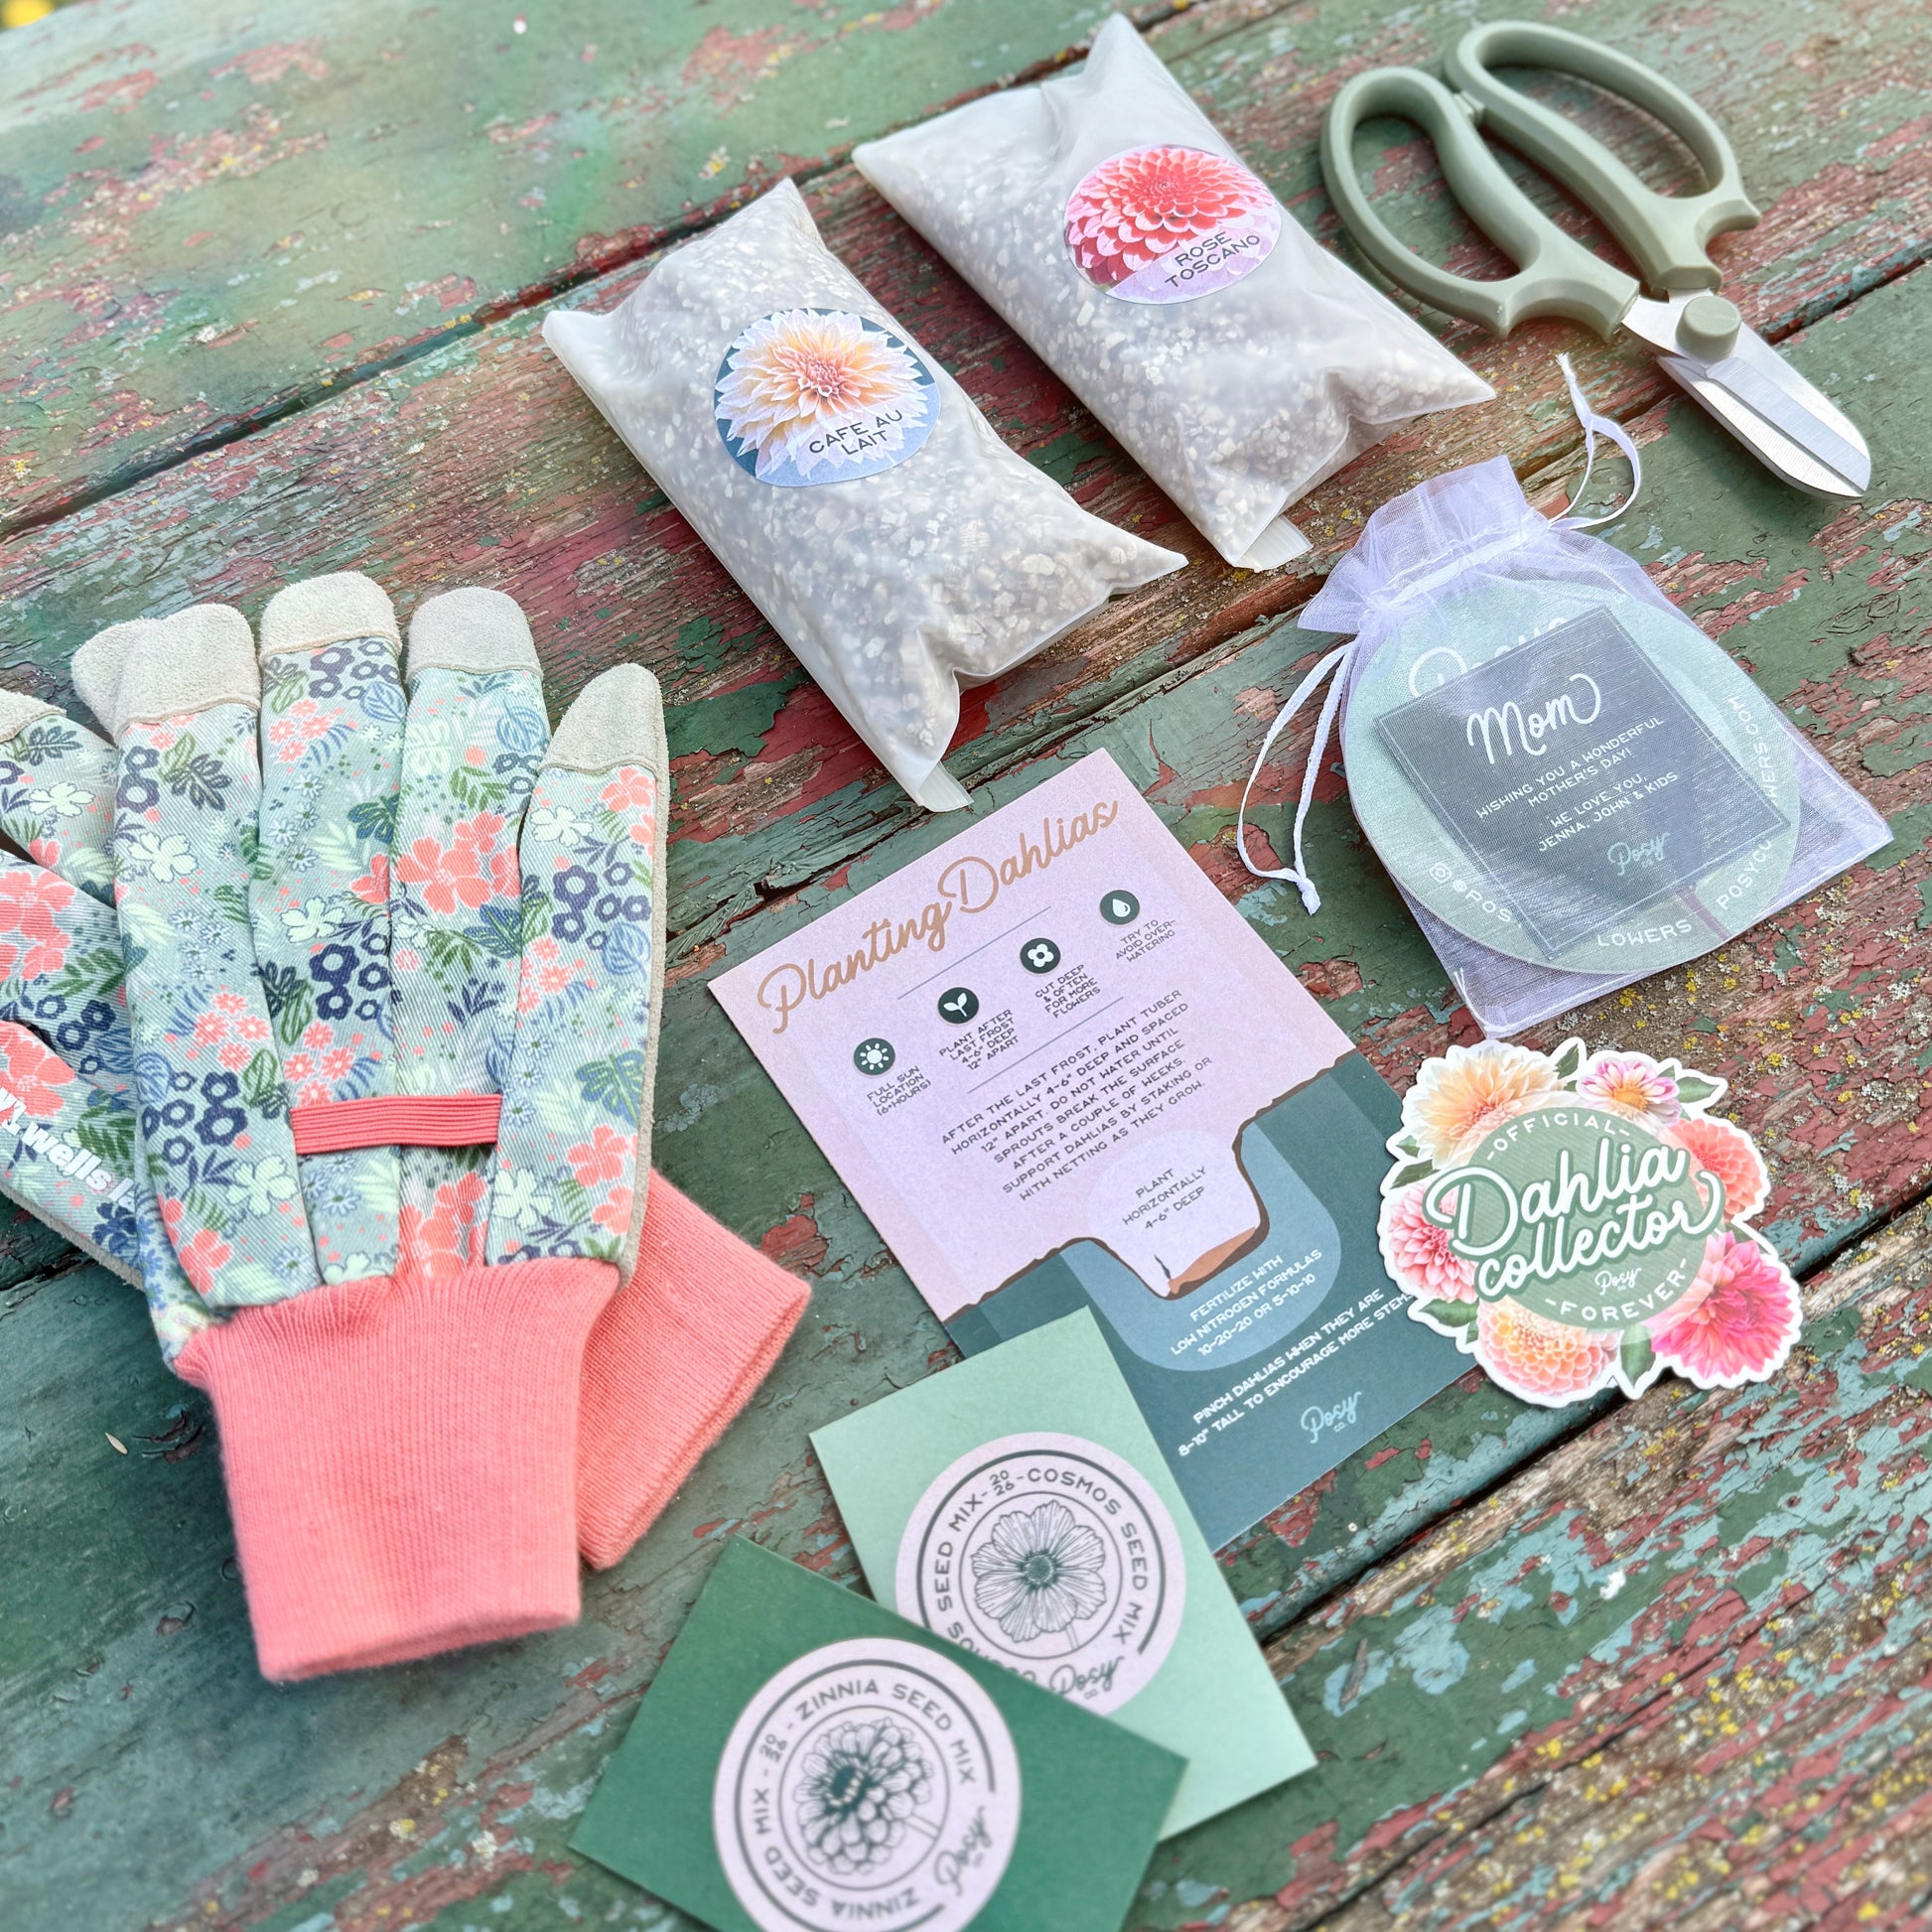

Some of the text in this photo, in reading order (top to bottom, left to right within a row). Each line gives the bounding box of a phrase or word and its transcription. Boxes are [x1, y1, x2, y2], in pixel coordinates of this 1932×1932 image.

[1165, 234, 1260, 287] TOSCANO
[1174, 231, 1232, 266] ROSE
[809, 409, 903, 454] CAFE AU
[841, 430, 888, 455] LAIT
[1466, 673, 1600, 764] Mom
[1475, 717, 1665, 819] WISHING YOU A WONDERFUL
[1527, 747, 1632, 807] MOTHER'S DAY!
[1539, 771, 1678, 852] JENNA, JOHN & KIDS
[1550, 773, 1647, 828] WE LOVE YOU,
[1607, 832, 1671, 877] Posy
[757, 799, 1118, 1034] Planting Dahlias
[1116, 919, 1175, 960] AVOID OVER-
[1120, 919, 1159, 945] TRY TO
[1126, 929, 1175, 963] WATERING
[1035, 964, 1084, 998] CUT DEEP
[1044, 977, 1097, 1014] FOR MORE
[1052, 986, 1101, 1019] FLOWERS
[1053, 973, 1088, 997] OFTEN
[939, 1009, 1013, 1056] PLANT AFTER
[949, 1017, 1015, 1060] LAST FROST
[987, 1028, 1015, 1048] DEEP
[987, 1035, 1019, 1060] APART
[867, 1065, 920, 1101] FULL SUN
[873, 1073, 924, 1108] LOCATION
[942, 989, 1182, 1144] AFTER THE LAST FROST. PLANT TUBER
[951, 1094, 1041, 1155] HORIZONTALLY
[1076, 1051, 1109, 1076] DEEP
[1115, 1034, 1139, 1053] AND
[1141, 1003, 1188, 1035] SPACED
[1049, 1095, 1068, 1110] DO
[1070, 1077, 1096, 1097] NOT
[1099, 1049, 1141, 1079] WATER
[1142, 1027, 1178, 1051] UNTIL
[994, 1038, 1184, 1163] SPROUTS BREAK THE SURFACE
[1003, 1056, 1213, 1193] SUPPORT DAHLIAS BY STAKING OR
[1013, 1057, 1185, 1170] AFTER A COUPLE OF WEEKS.
[22, 1121, 112, 1190] wells
[1020, 1080, 1205, 1200] WITH NETTING AS THEY GROW.
[1122, 1166, 1206, 1226] HORIZONTALLY
[1136, 1169, 1173, 1198] PLANT
[1173, 1185, 1205, 1211] DEEP
[1426, 1138, 1687, 1256] Dahlia
[1478, 1169, 1723, 1297] collector
[1170, 1248, 1322, 1356] LOW NITROGEN FORMULAS
[1189, 1255, 1284, 1321] FERTILIZE WITH
[1594, 1267, 1642, 1296] Posy
[1197, 1273, 1316, 1356] 10-20-20 OR 5-10-10
[1177, 1294, 1414, 1457] 8-10" TALL TO ENCOURAGE MORE STEM
[1192, 1288, 1385, 1425] PINCH DAHLIAS WHEN THEY ARE
[1300, 1390, 1363, 1444] Posy
[989, 1470, 1010, 1485] 20
[934, 1541, 954, 1611] SEED
[1121, 1522, 1149, 1591] SEED
[1112, 1601, 1143, 1644] MIX
[1048, 1655, 1125, 1695] Posy
[795, 1678, 976, 1785] ZINNIA SEED MIX
[753, 1788, 919, 1920] ZINNIA SEED MIX
[933, 1805, 993, 1897] Posy
